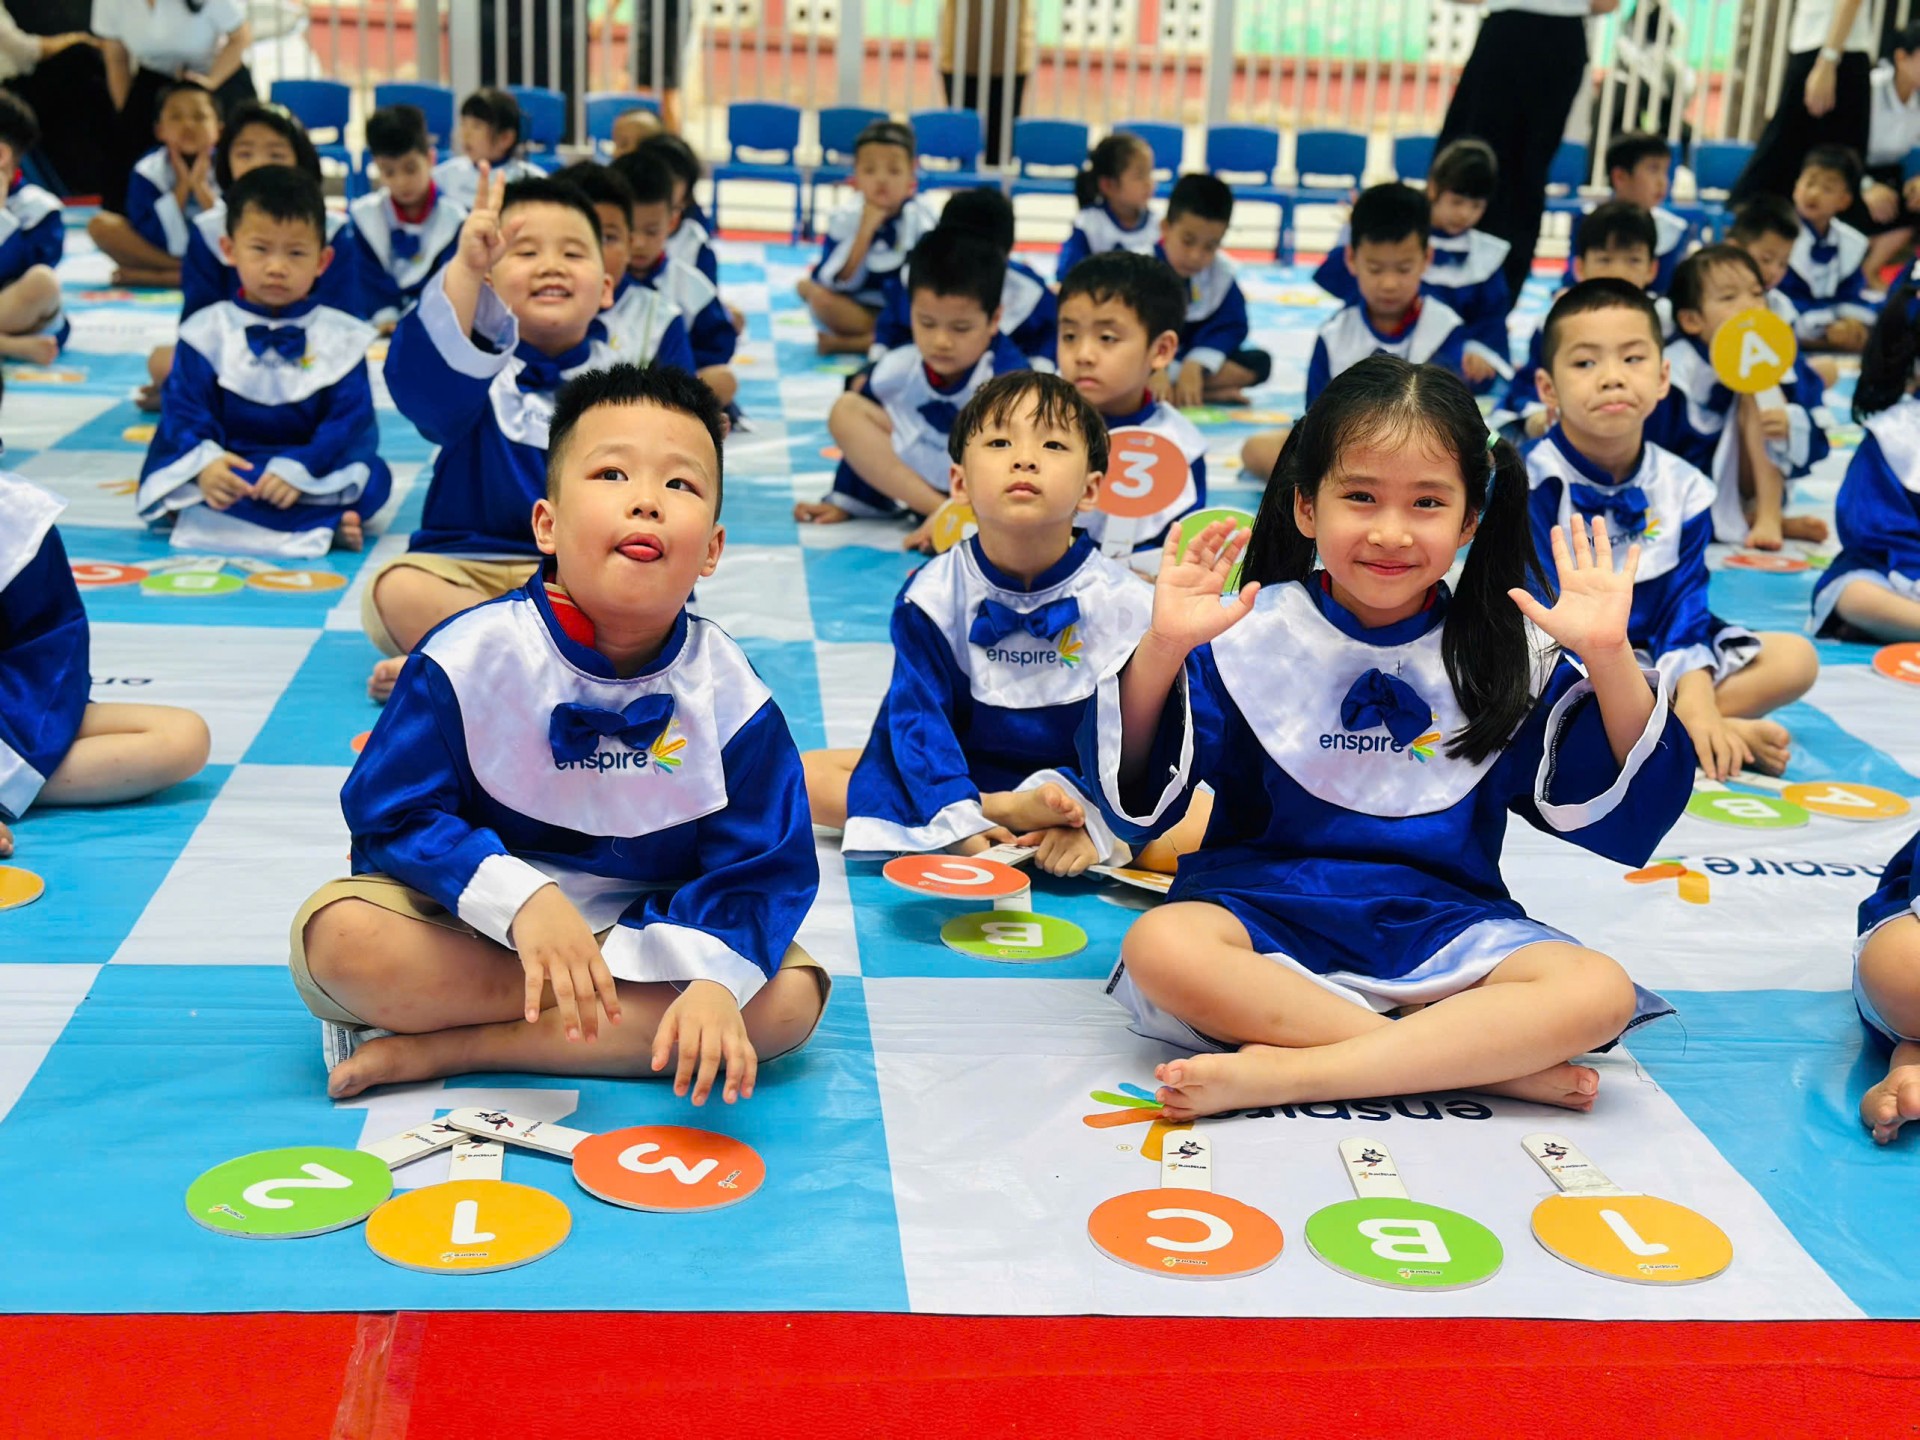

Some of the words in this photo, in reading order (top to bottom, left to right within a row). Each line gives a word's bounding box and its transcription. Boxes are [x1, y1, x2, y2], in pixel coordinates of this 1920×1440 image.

[1739, 330, 1780, 379] A
[1111, 450, 1158, 498] 3
[986, 648, 1057, 667] enspire
[1319, 733, 1404, 754] enspire
[1712, 798, 1781, 818] B
[1803, 786, 1877, 807] A
[921, 863, 995, 885] C
[1703, 857, 1886, 877] nspire
[980, 921, 1044, 947] B
[618, 1142, 719, 1185] 3
[242, 1163, 353, 1209] 2
[451, 1200, 496, 1245] 1
[1146, 1208, 1233, 1251] C
[1357, 1218, 1451, 1262] B
[1599, 1209, 1668, 1256] 1
